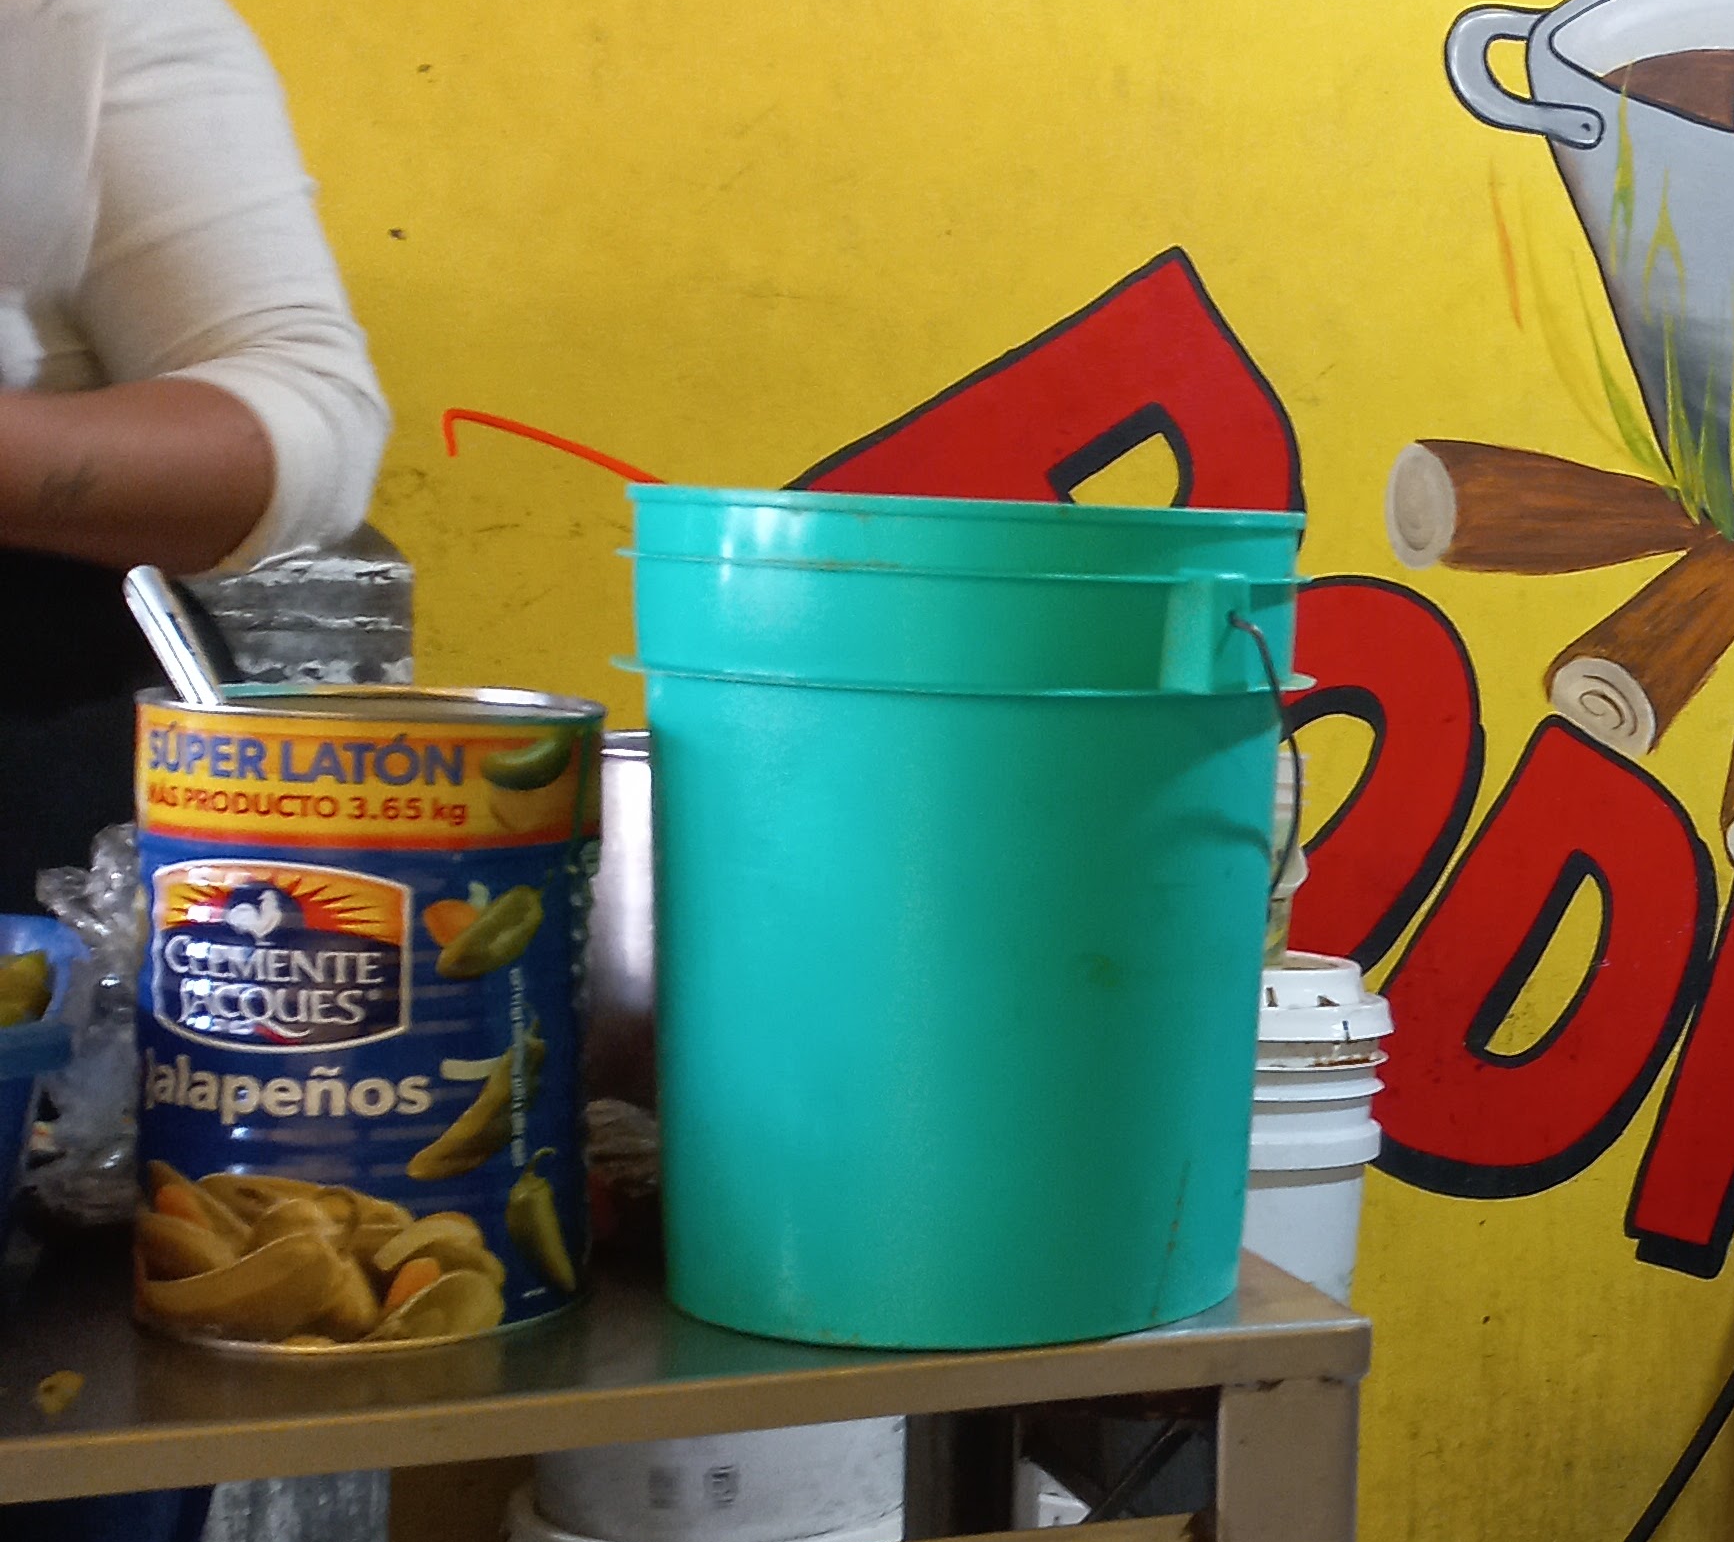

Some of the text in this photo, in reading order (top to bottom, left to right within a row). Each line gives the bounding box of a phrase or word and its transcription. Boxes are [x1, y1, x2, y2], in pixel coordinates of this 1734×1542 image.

[149, 721, 464, 786] SÚPER LATÓN
[184, 787, 338, 819] PRODUCTO
[348, 797, 424, 821] 3.65
[431, 798, 468, 826] kg
[165, 935, 385, 984] CLEMENTE
[178, 978, 366, 1038] JACQUES
